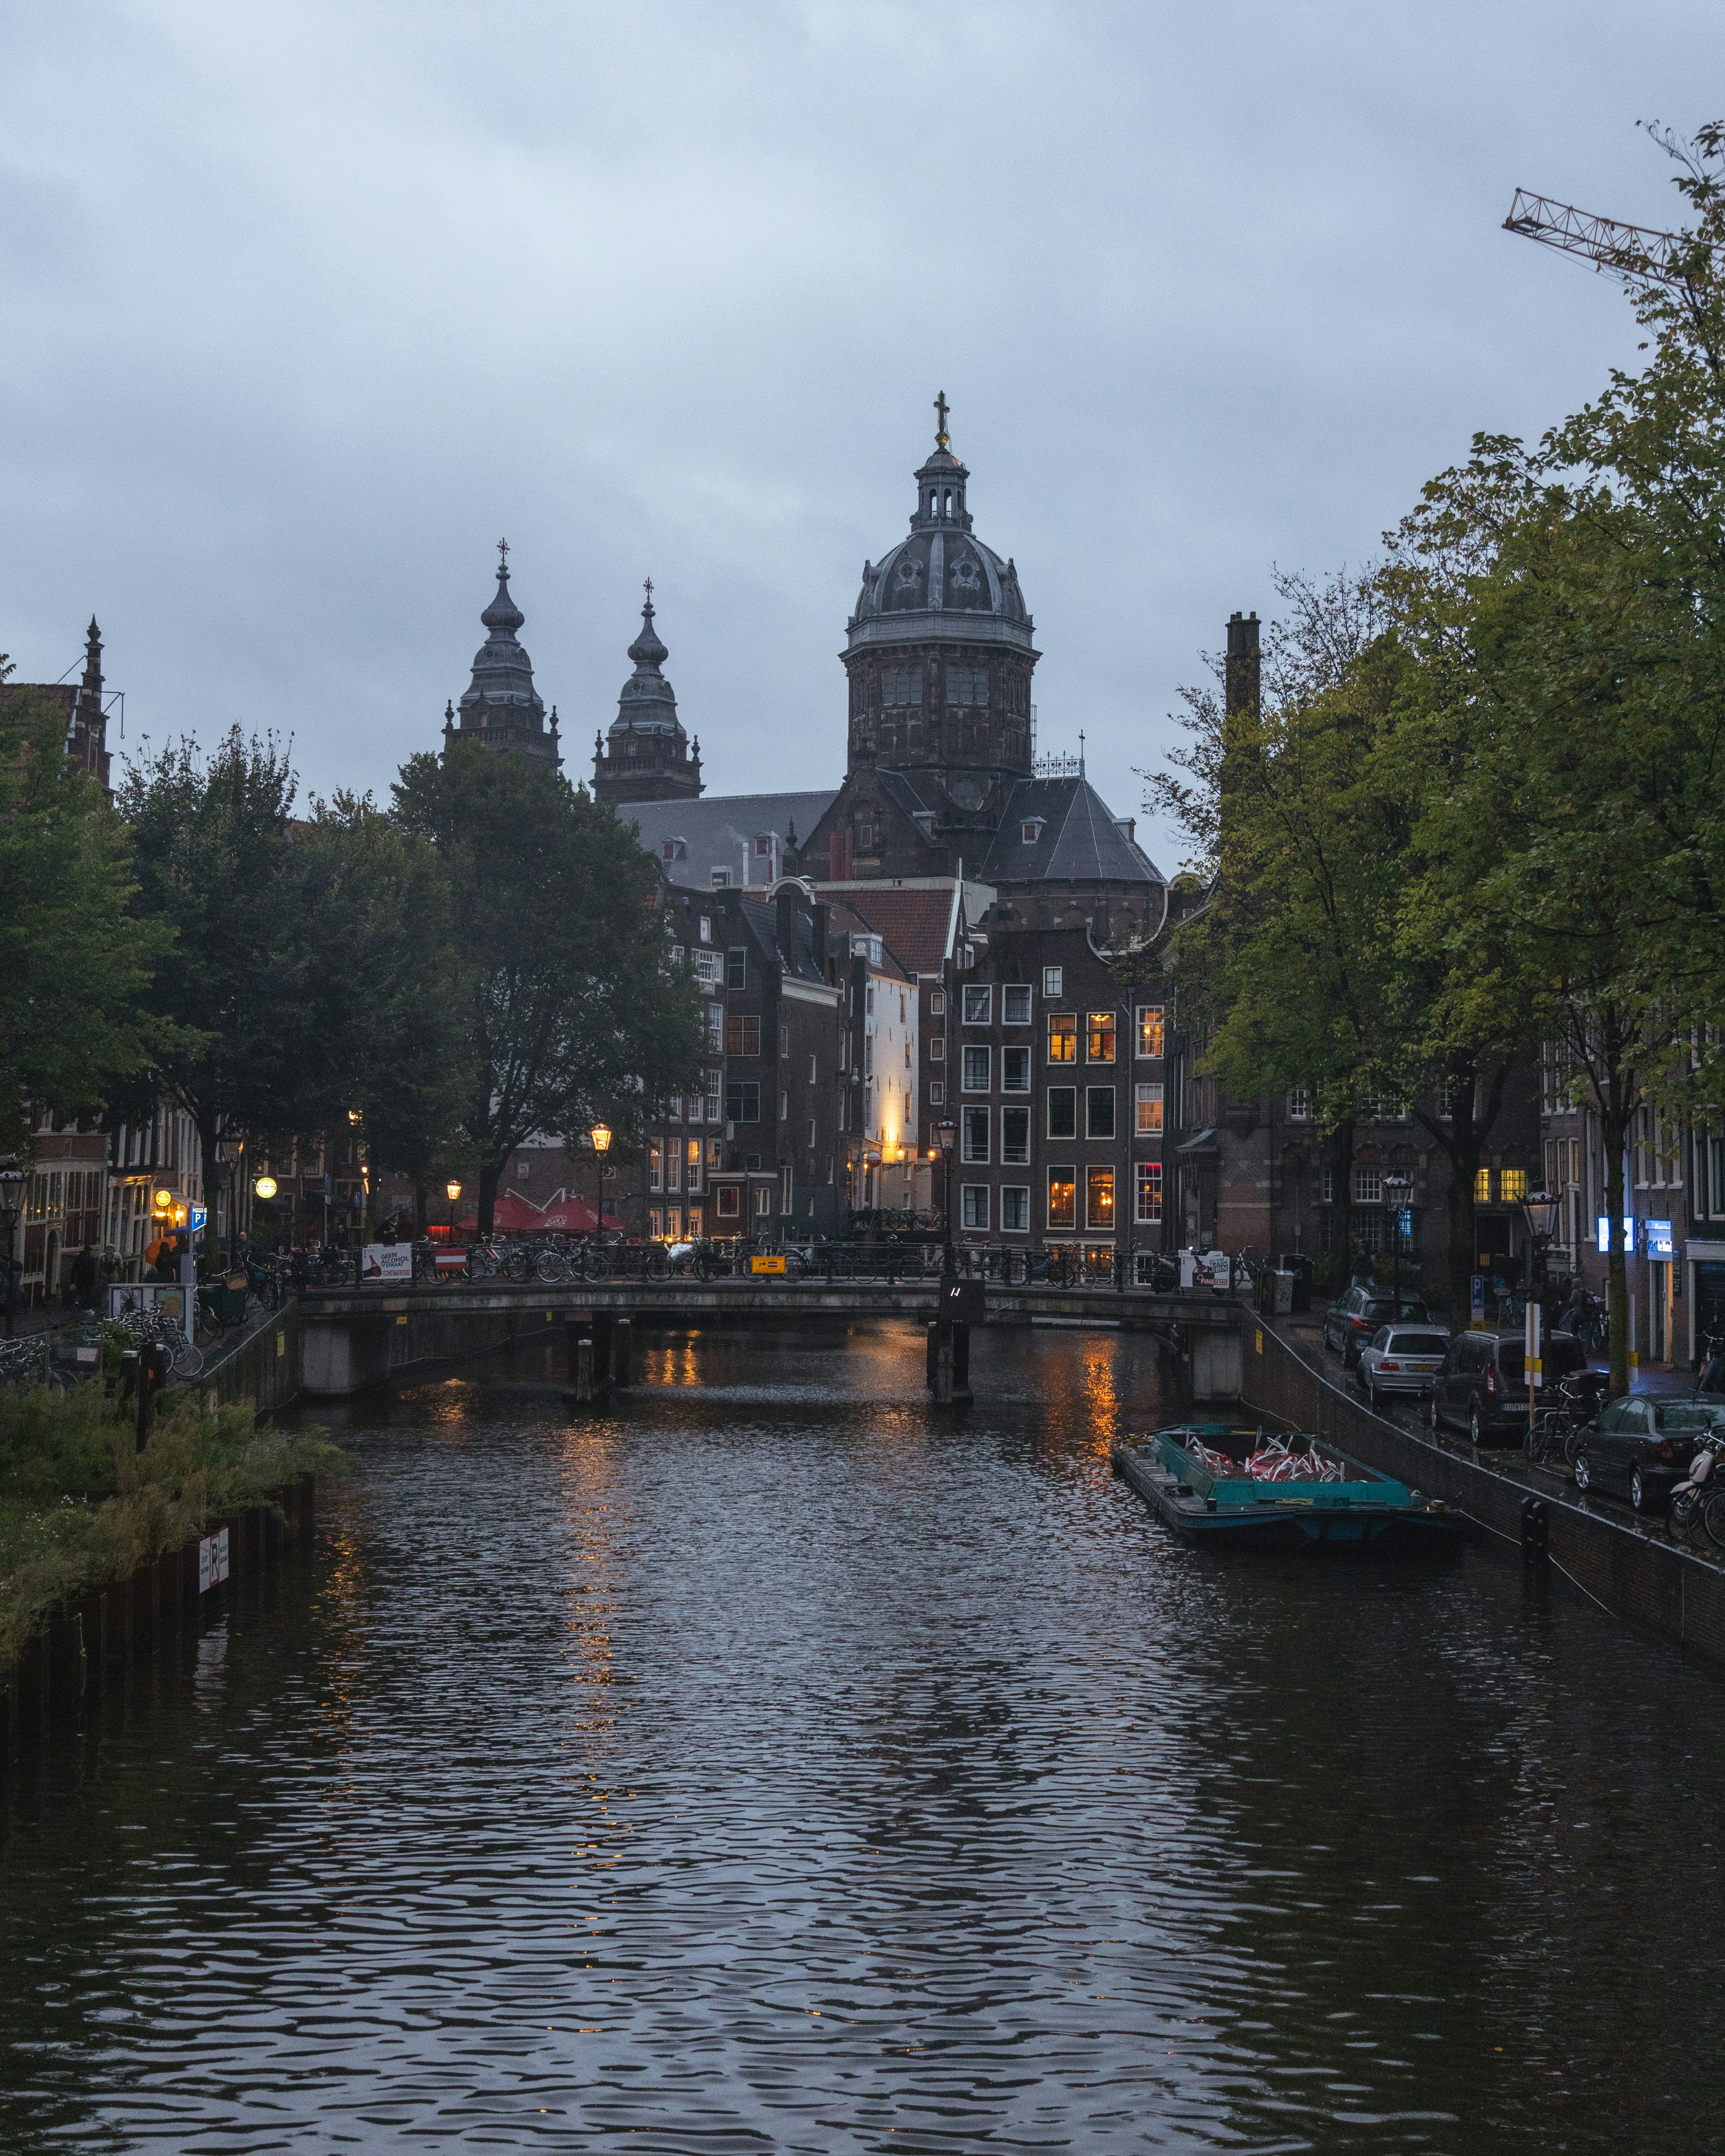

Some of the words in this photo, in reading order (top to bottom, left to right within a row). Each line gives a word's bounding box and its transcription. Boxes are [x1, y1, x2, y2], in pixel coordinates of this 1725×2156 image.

[195, 1213, 201, 1224] P
[381, 1256, 409, 1264] ALCOHOL
[1474, 1278, 1481, 1295] P
